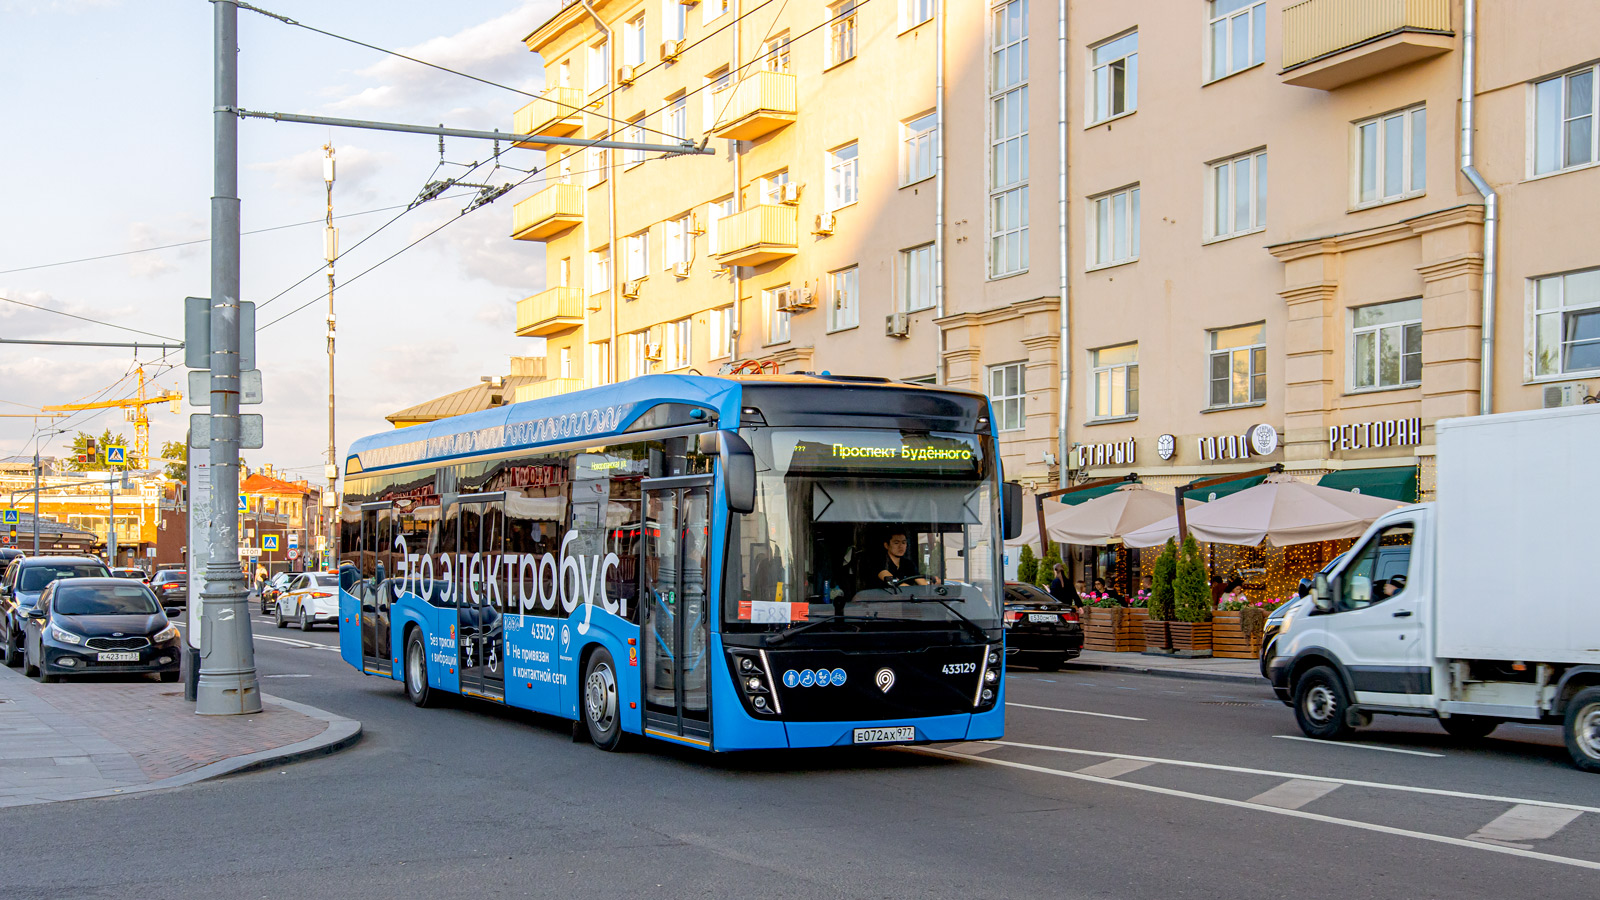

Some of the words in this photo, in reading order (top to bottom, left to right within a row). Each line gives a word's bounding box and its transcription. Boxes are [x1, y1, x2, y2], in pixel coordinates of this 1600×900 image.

[1329, 417, 1421, 451] РЕСТОРАН
[832, 443, 896, 459] Проспект
[901, 445, 971, 461] Будённого
[1078, 437, 1136, 466] СТАРЫЙ
[1198, 435, 1250, 460] ГОРОД
[394, 534, 434, 602] Это
[440, 529, 628, 635] электробус.
[531, 623, 555, 641] 433129
[512, 644, 521, 659] Не
[521, 648, 550, 663] привязан
[512, 666, 517, 677] к
[517, 667, 551, 683] контактной
[552, 673, 567, 685] сети
[941, 662, 976, 675] 433129
[857, 729, 896, 742] Е072АХ
[897, 727, 912, 737] 977
